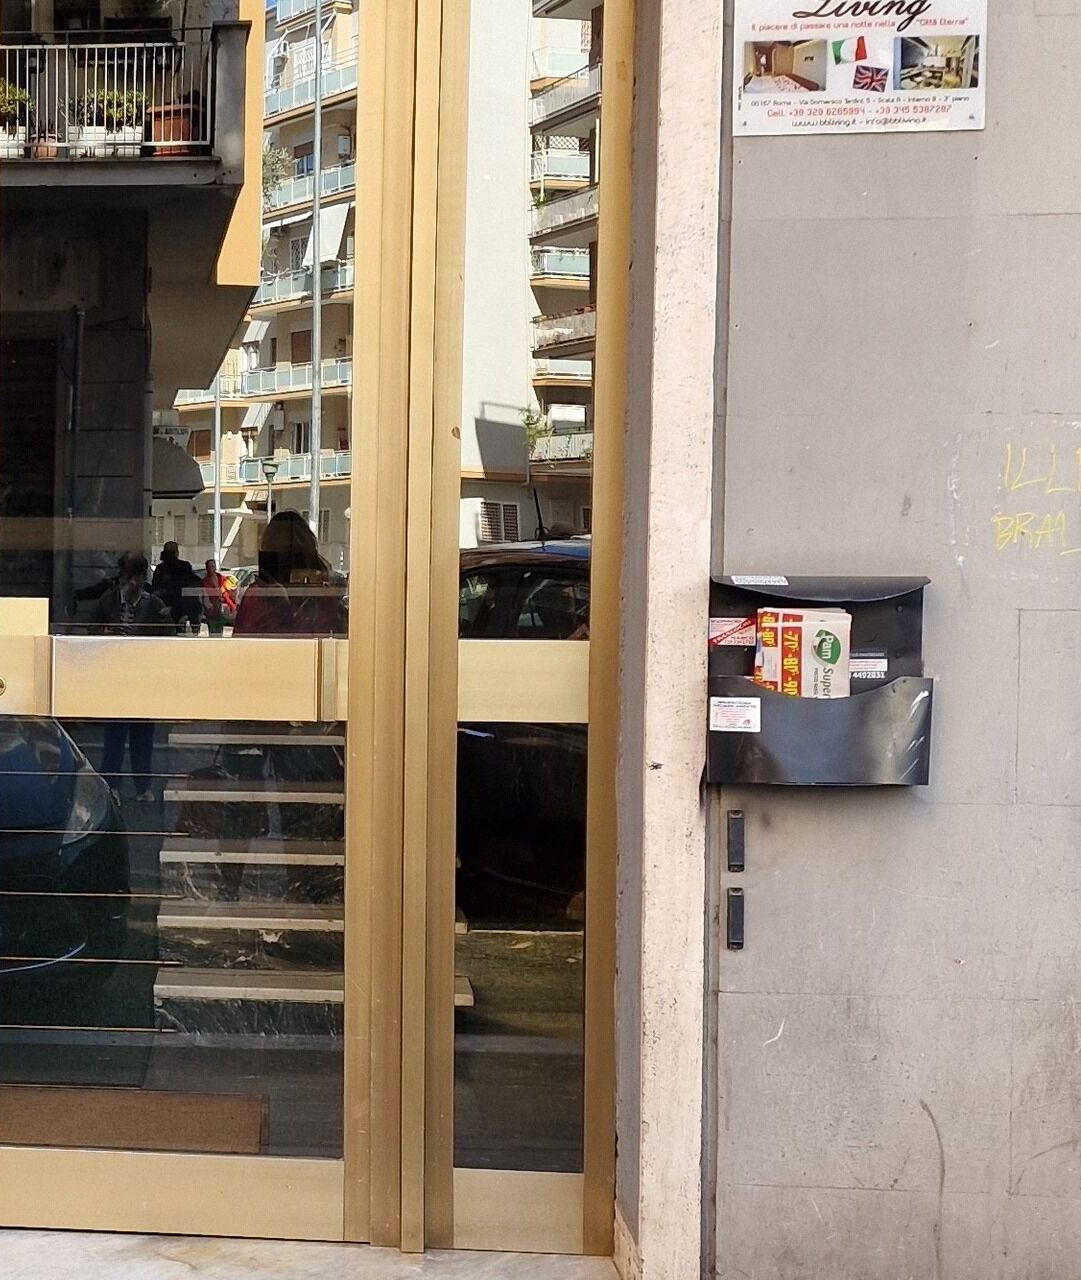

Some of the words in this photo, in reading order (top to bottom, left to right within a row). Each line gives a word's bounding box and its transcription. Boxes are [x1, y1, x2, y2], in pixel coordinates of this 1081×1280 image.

[758, 24, 788, 32] piacere
[800, 23, 831, 31] passare
[822, 634, 835, 659] Pam
